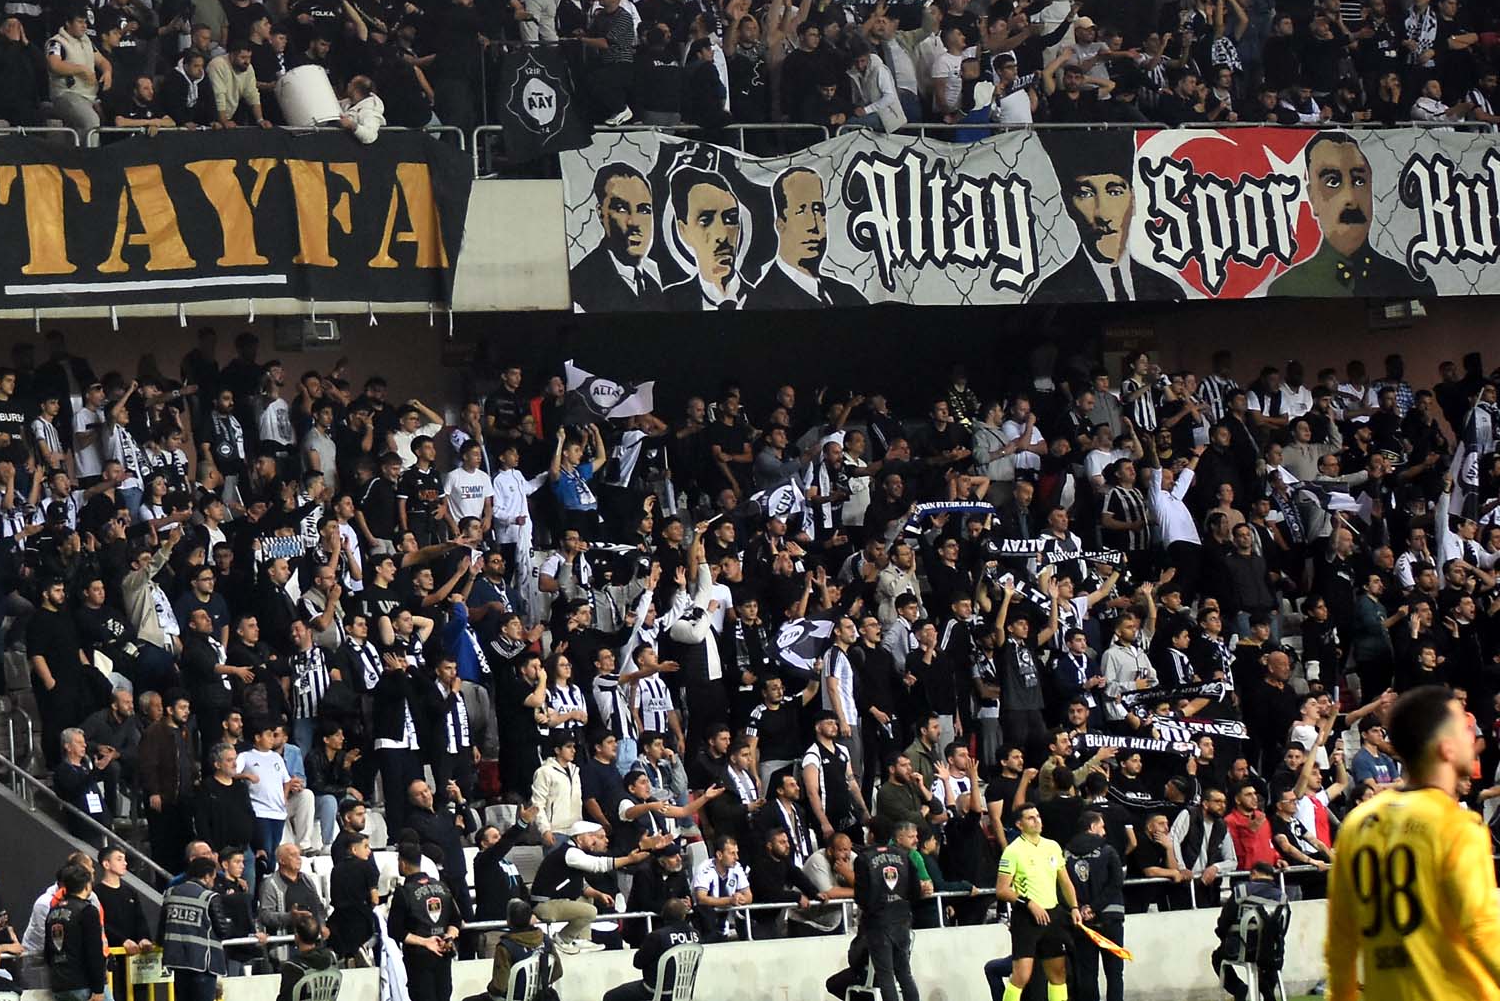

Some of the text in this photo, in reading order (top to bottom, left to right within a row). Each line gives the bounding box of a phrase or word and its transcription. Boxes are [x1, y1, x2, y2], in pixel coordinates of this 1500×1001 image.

[843, 152, 1037, 292] Altay
[1137, 155, 1300, 295] Spor
[461, 485, 484, 494] TOMMY
[1351, 843, 1425, 939] 98
